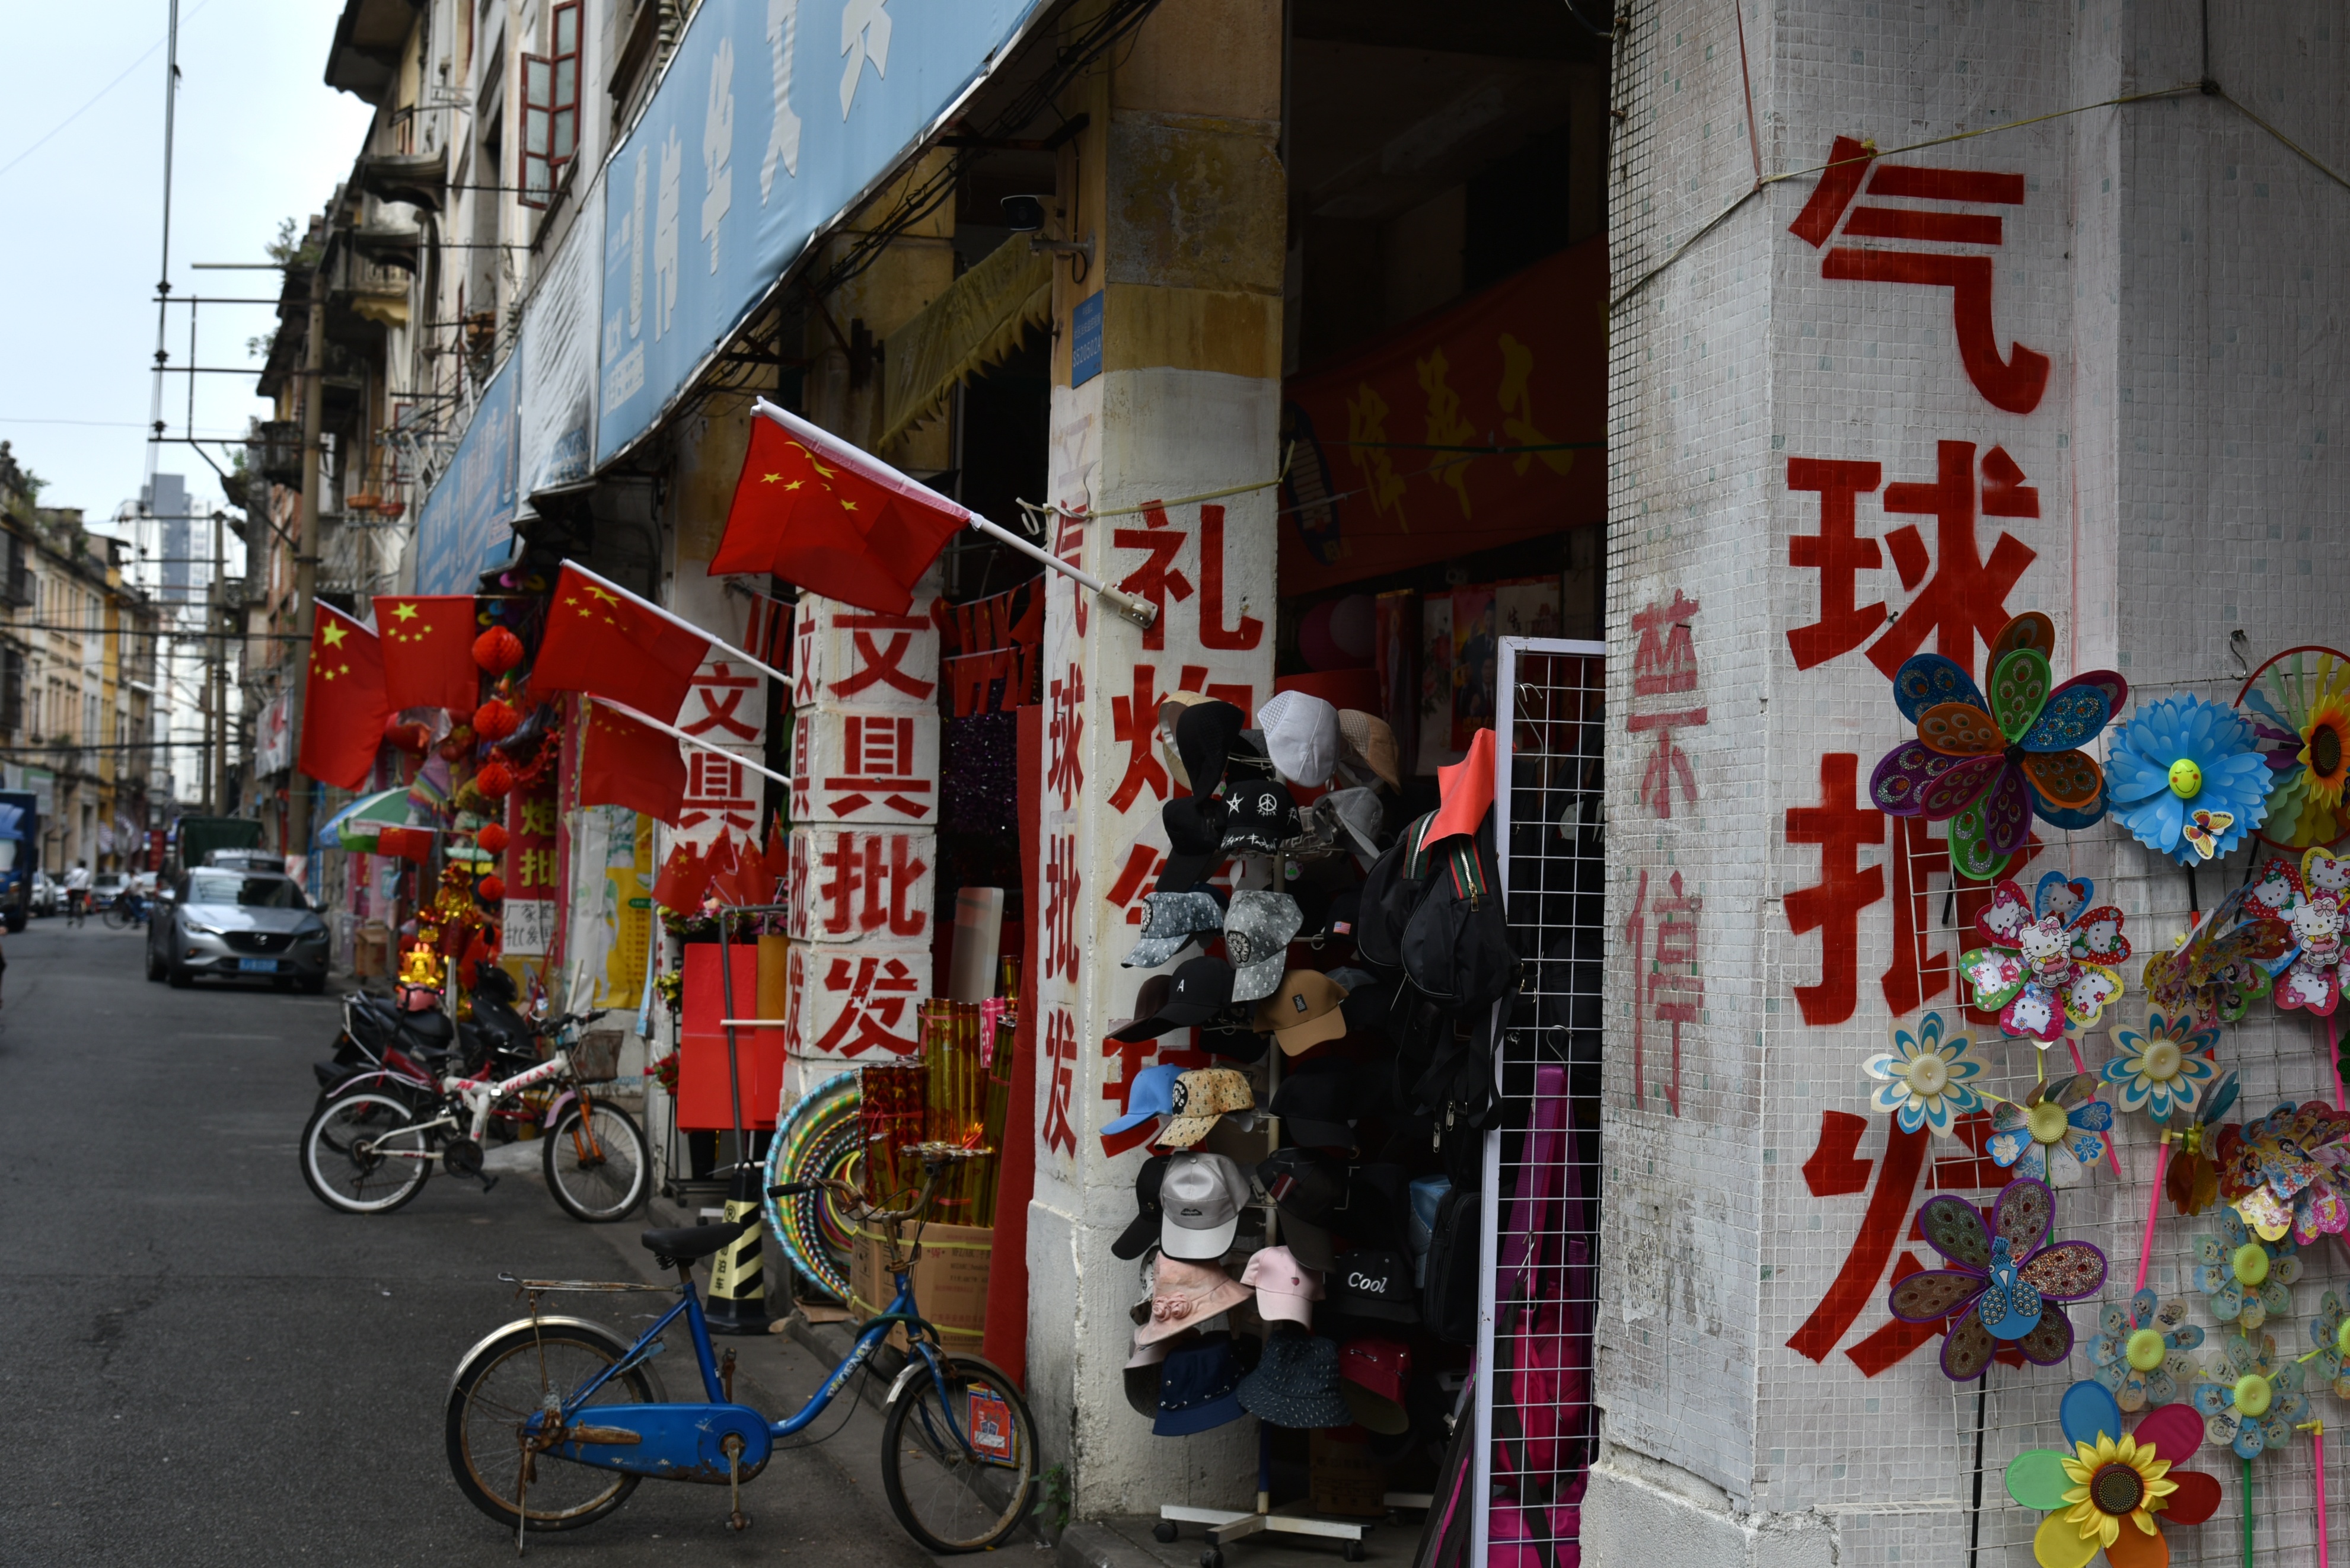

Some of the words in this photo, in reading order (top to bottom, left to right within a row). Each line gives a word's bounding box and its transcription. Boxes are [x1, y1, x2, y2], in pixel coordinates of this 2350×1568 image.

[815, 614, 938, 1059] 文具批发
[1176, 979, 1185, 992] A
[1348, 1272, 1388, 1294] Cool
